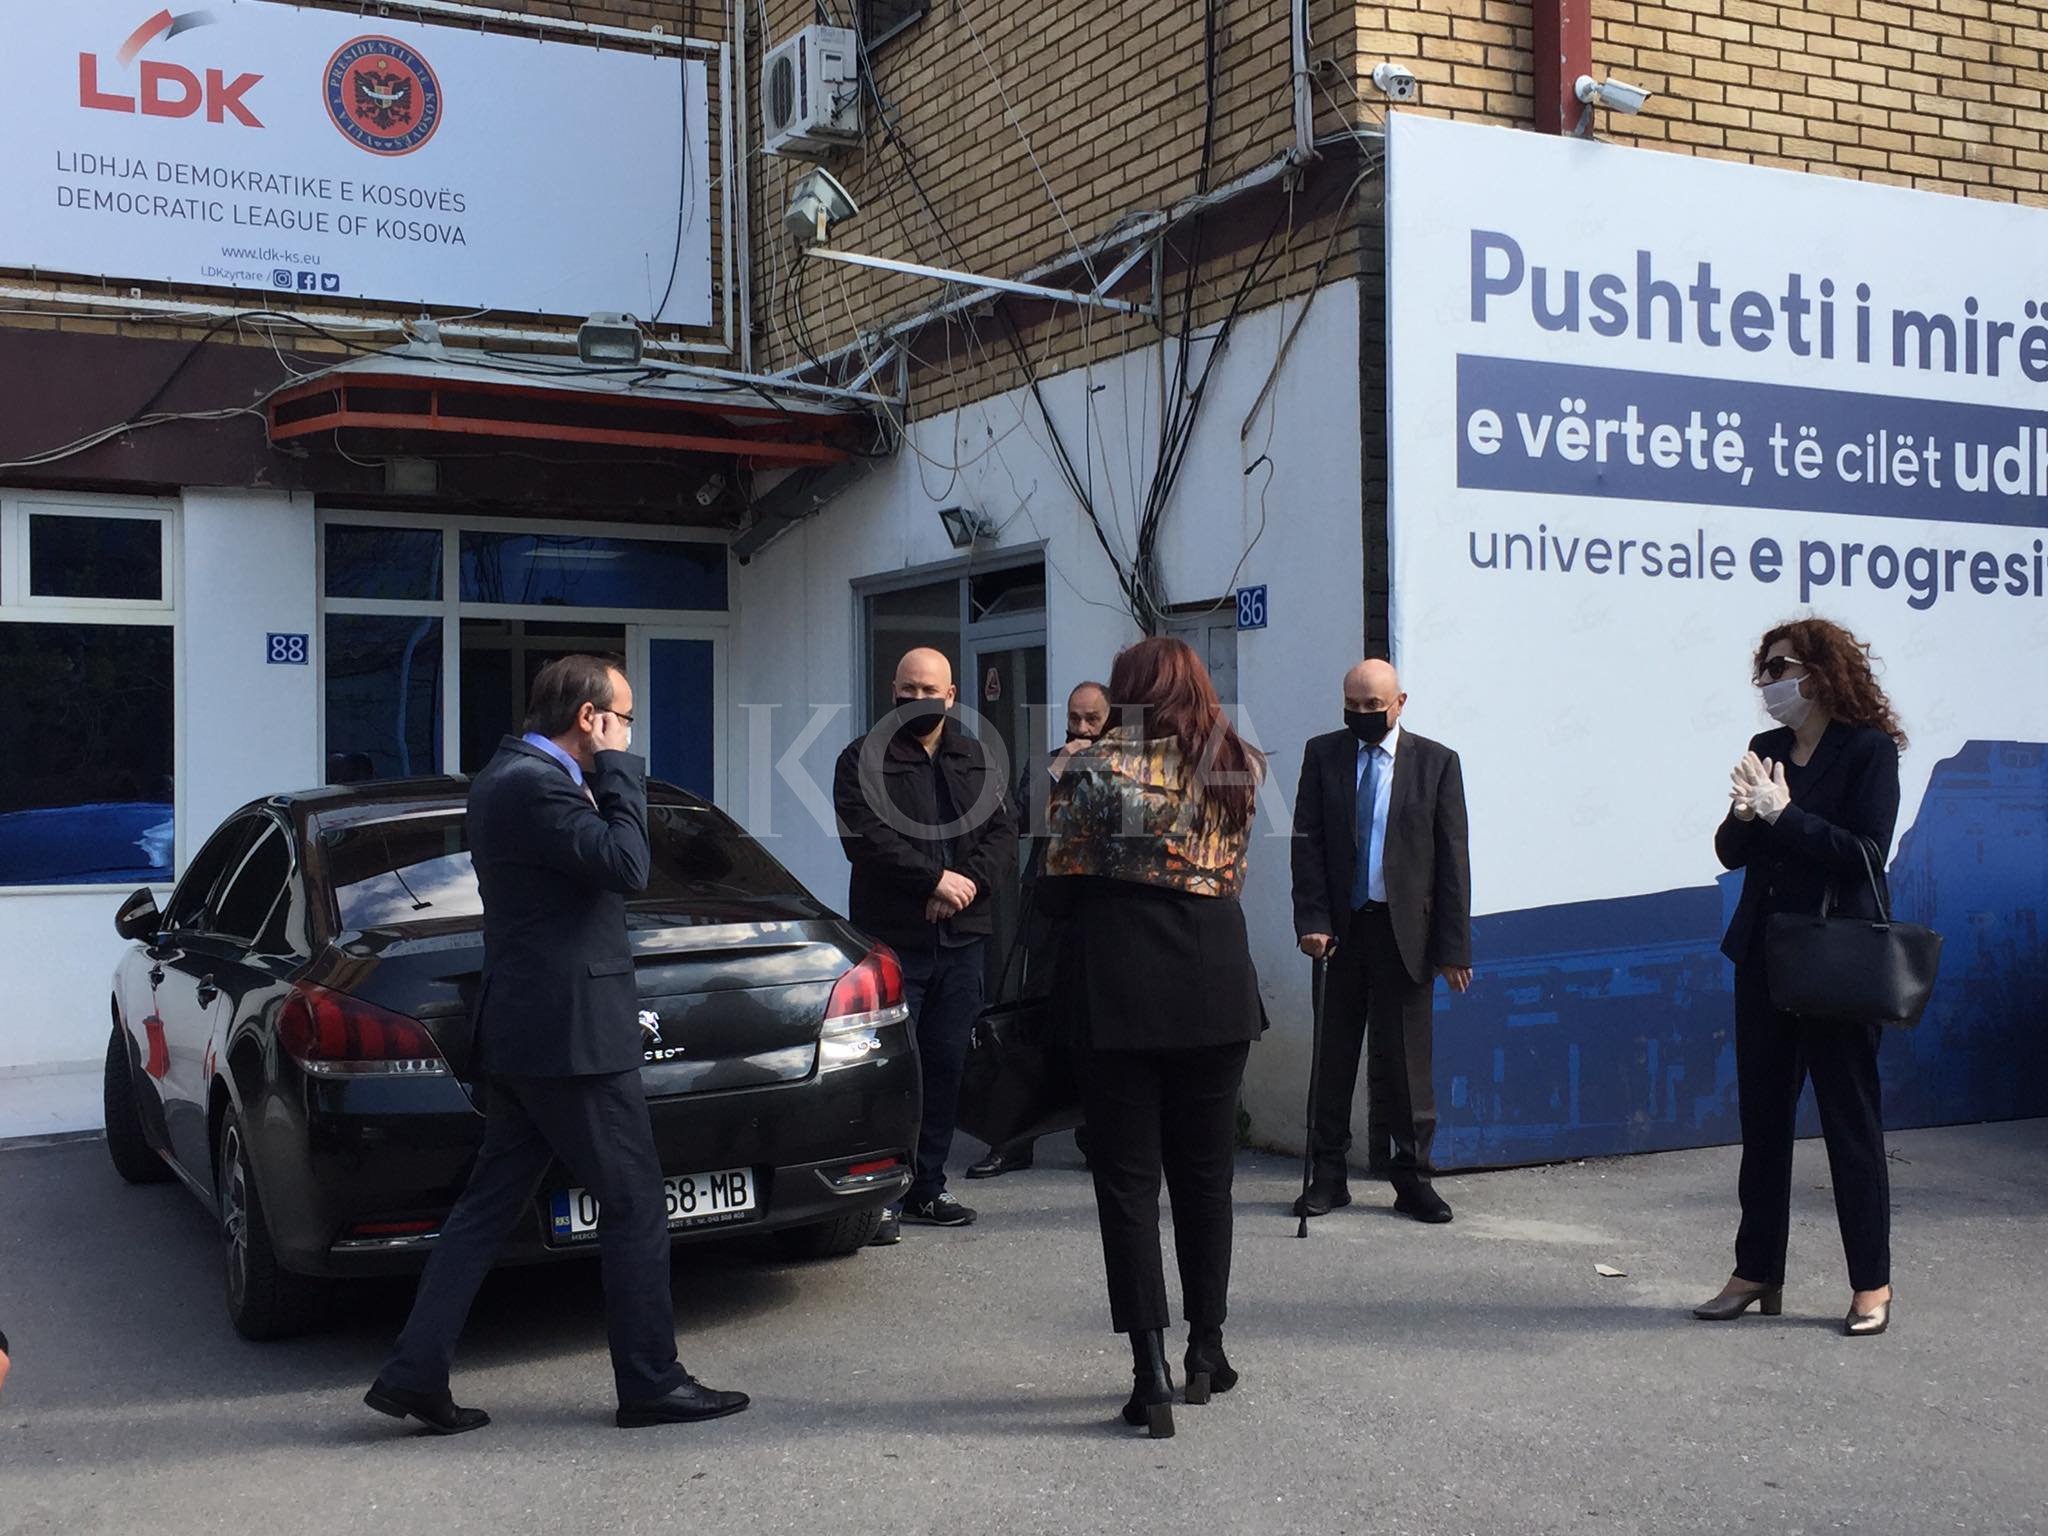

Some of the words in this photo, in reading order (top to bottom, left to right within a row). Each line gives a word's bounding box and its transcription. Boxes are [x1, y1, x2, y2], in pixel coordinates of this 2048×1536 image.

[79, 52, 265, 128] LDK
[57, 151, 149, 180] LIDHJA
[157, 161, 332, 199] DEMOKRATIKE
[341, 181, 353, 201] E
[362, 184, 466, 212] KOSOVËS
[57, 186, 224, 222] DEMOCRATIC
[233, 204, 329, 232] LEAGUE
[338, 214, 367, 236] OF
[376, 218, 466, 246] KOSOVA
[201, 265, 263, 281] LDKzyrtare
[221, 247, 320, 265] www.ldk-ks.eu
[1470, 229, 1834, 359] Pushteti
[1856, 282, 1871, 363] i
[1892, 296, 2048, 382] mirë
[1467, 407, 1503, 455] e
[1516, 396, 1754, 486] vërtetë,
[1770, 422, 1823, 480] të
[1836, 430, 1941, 489] cilët
[1469, 523, 1736, 581] universale
[1749, 537, 1783, 583] e
[1800, 537, 2048, 610] progresi
[1240, 589, 1264, 625] 86
[272, 636, 304, 661] 88
[644, 1047, 686, 1061] GEOT
[578, 1191, 598, 1226] 0
[664, 1172, 748, 1216] 68-MB
[571, 1231, 598, 1241] MERCO
